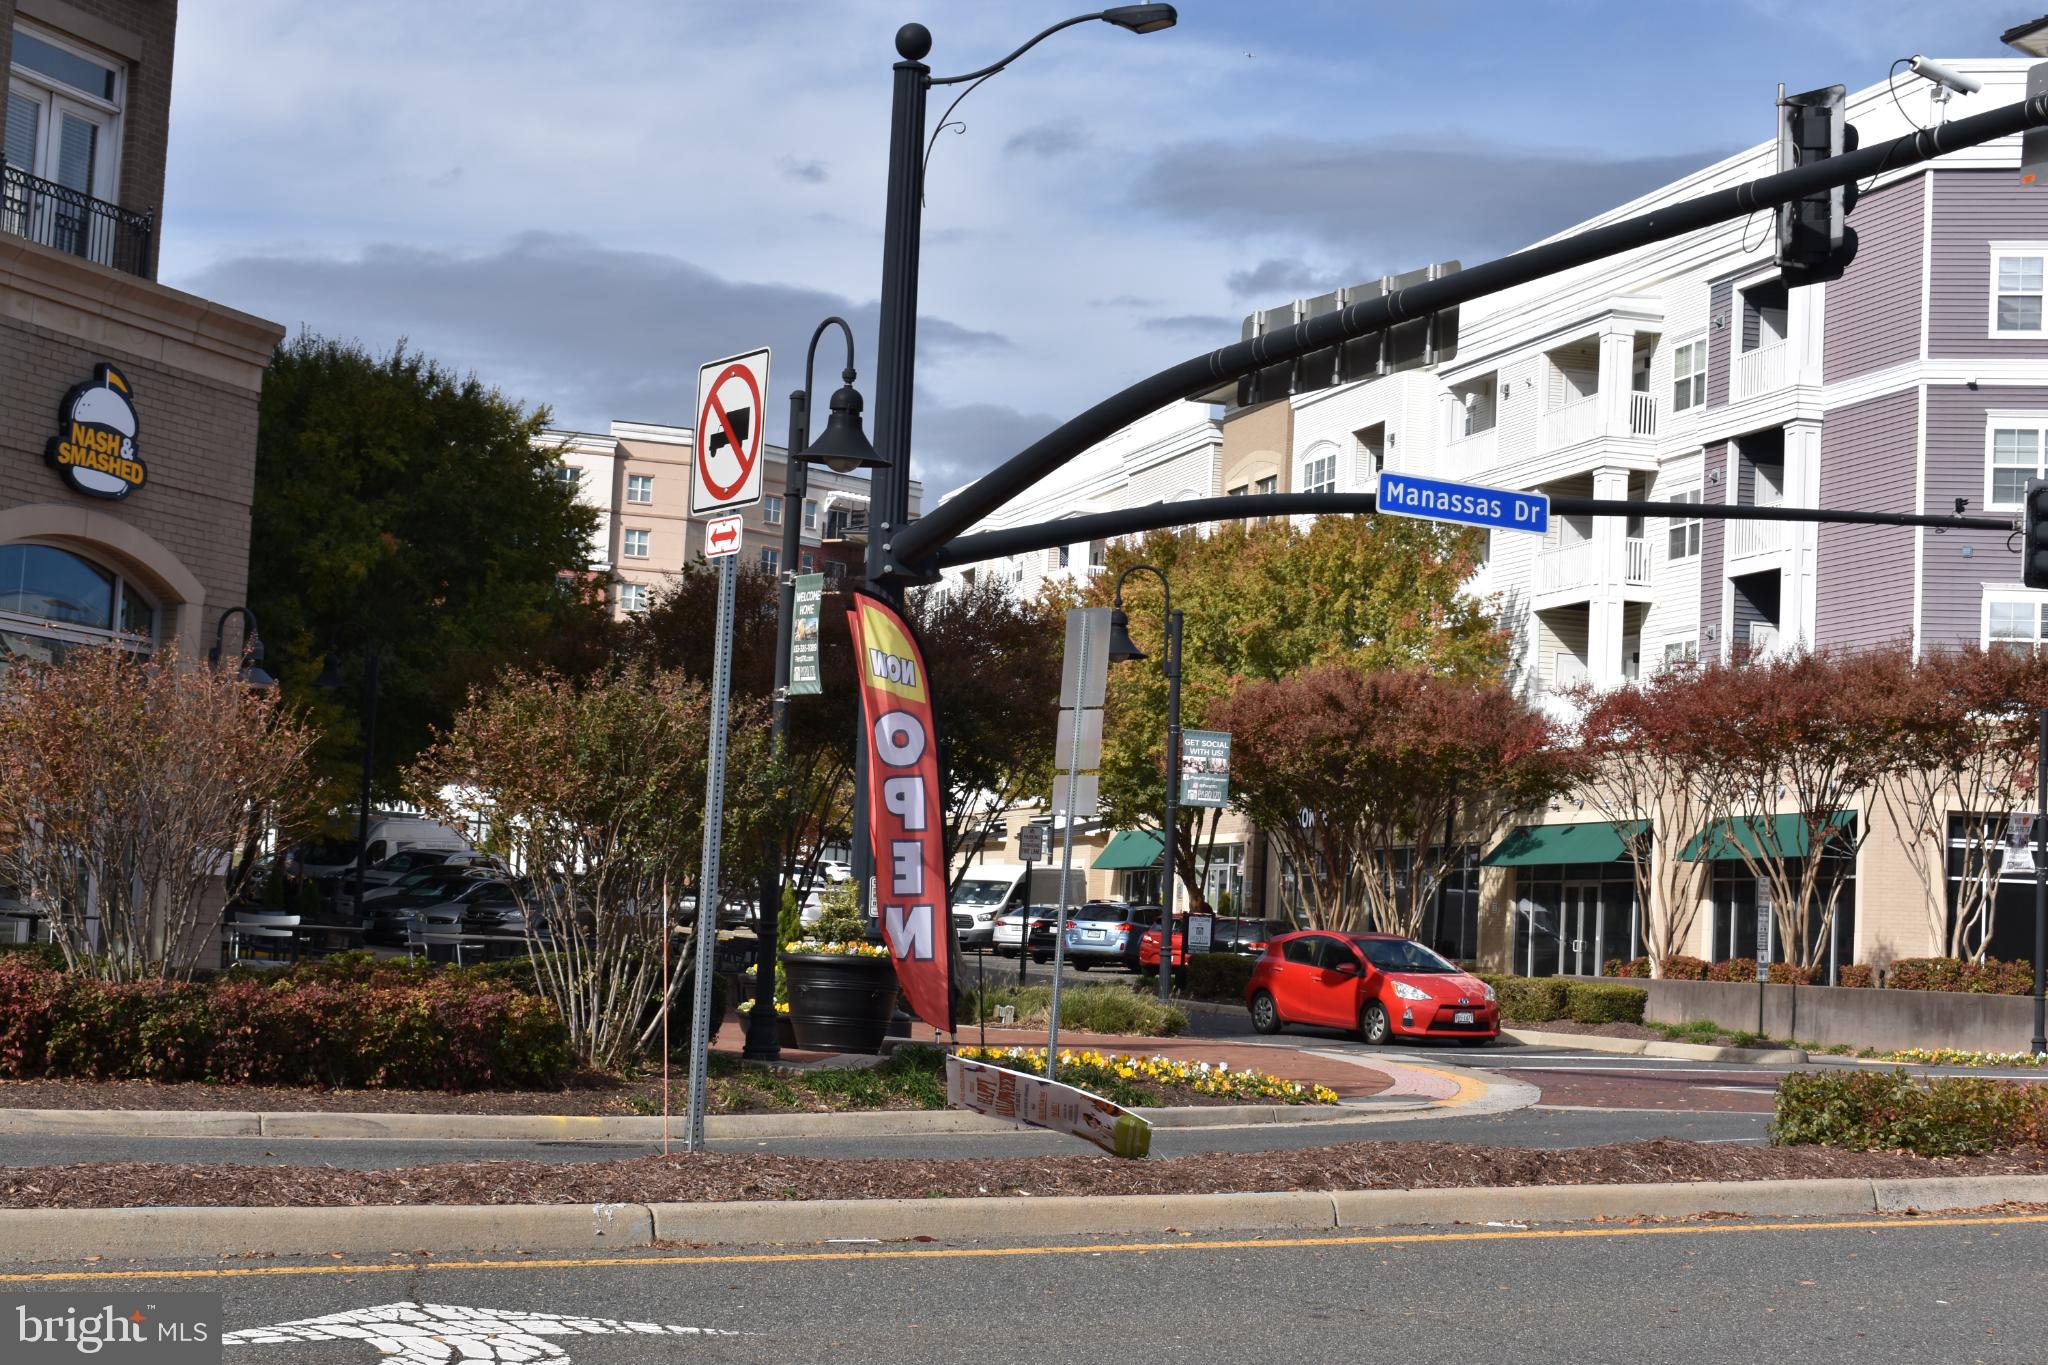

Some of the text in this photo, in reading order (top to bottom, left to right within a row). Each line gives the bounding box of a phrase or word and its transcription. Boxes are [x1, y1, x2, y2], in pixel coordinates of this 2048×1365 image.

[71, 421, 134, 460] NASH &
[57, 442, 144, 485] SMASHED
[1387, 481, 1541, 523] Manassas Dr
[796, 590, 821, 602] WELCOME
[799, 604, 815, 615] HOME
[1184, 738, 1229, 749] GET SOCIAL
[1189, 747, 1223, 757] WITH US!
